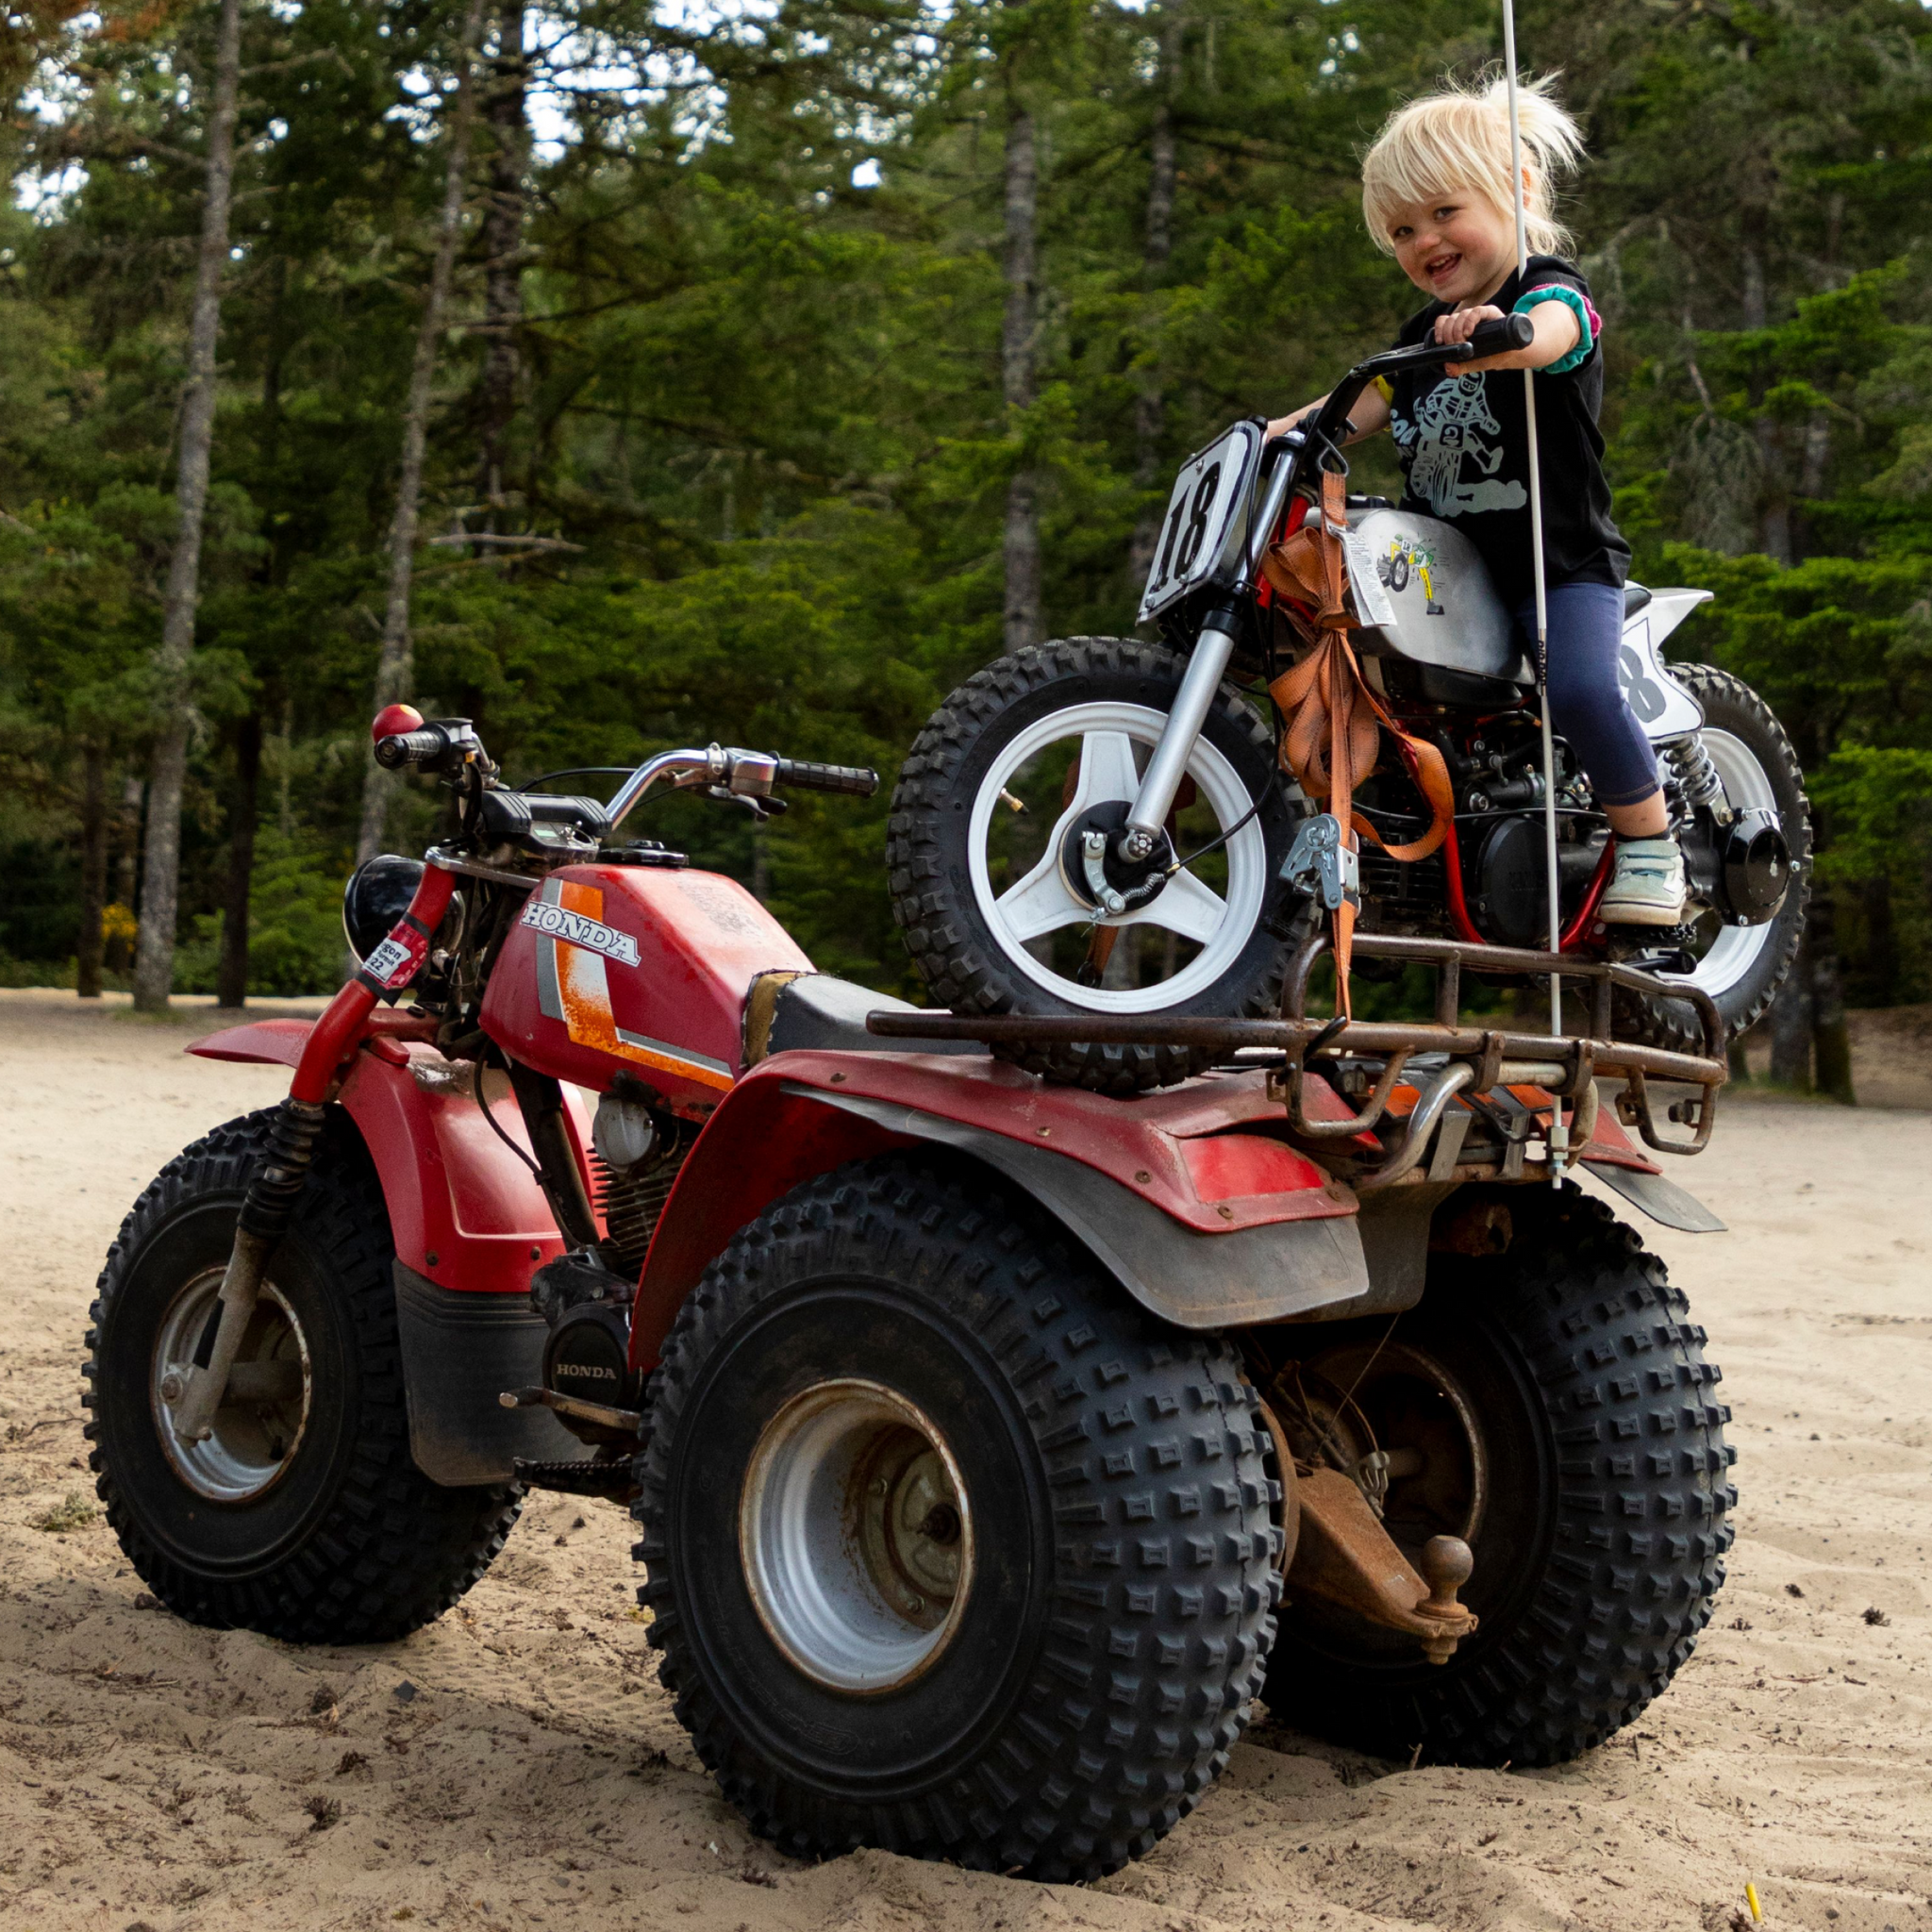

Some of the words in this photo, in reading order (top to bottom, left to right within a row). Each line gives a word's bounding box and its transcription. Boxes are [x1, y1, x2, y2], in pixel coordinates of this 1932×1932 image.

[1442, 425, 1459, 446] 2
[1149, 461, 1221, 593] 18
[521, 901, 641, 967] HONDA
[556, 1363, 617, 1380] HONDA
